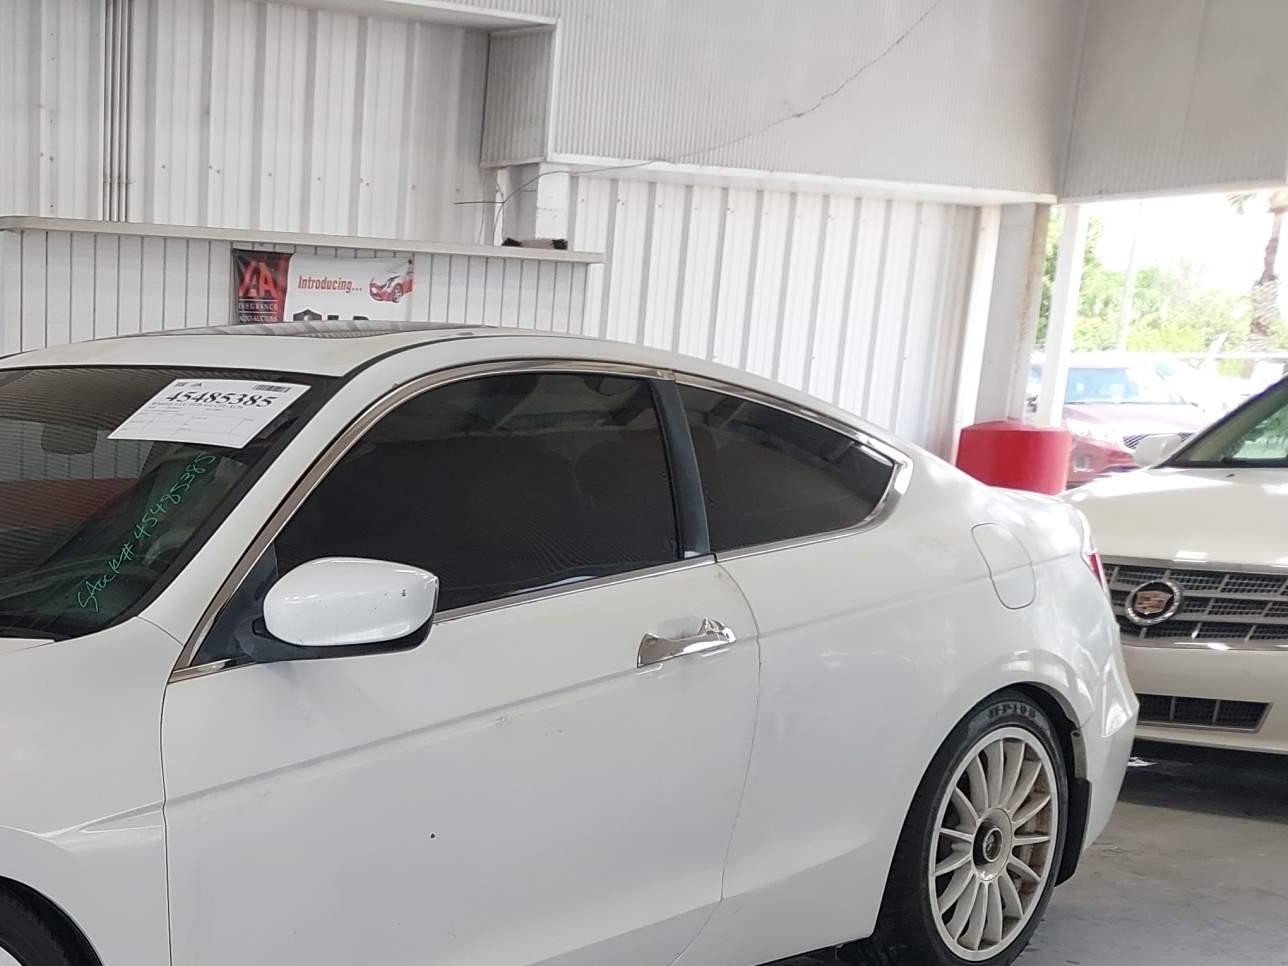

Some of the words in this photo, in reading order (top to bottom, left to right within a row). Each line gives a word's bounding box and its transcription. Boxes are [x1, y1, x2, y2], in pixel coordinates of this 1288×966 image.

[298, 275, 362, 293] Introducing...
[166, 391, 278, 407] 45485385
[134, 454, 216, 540] 45485385
